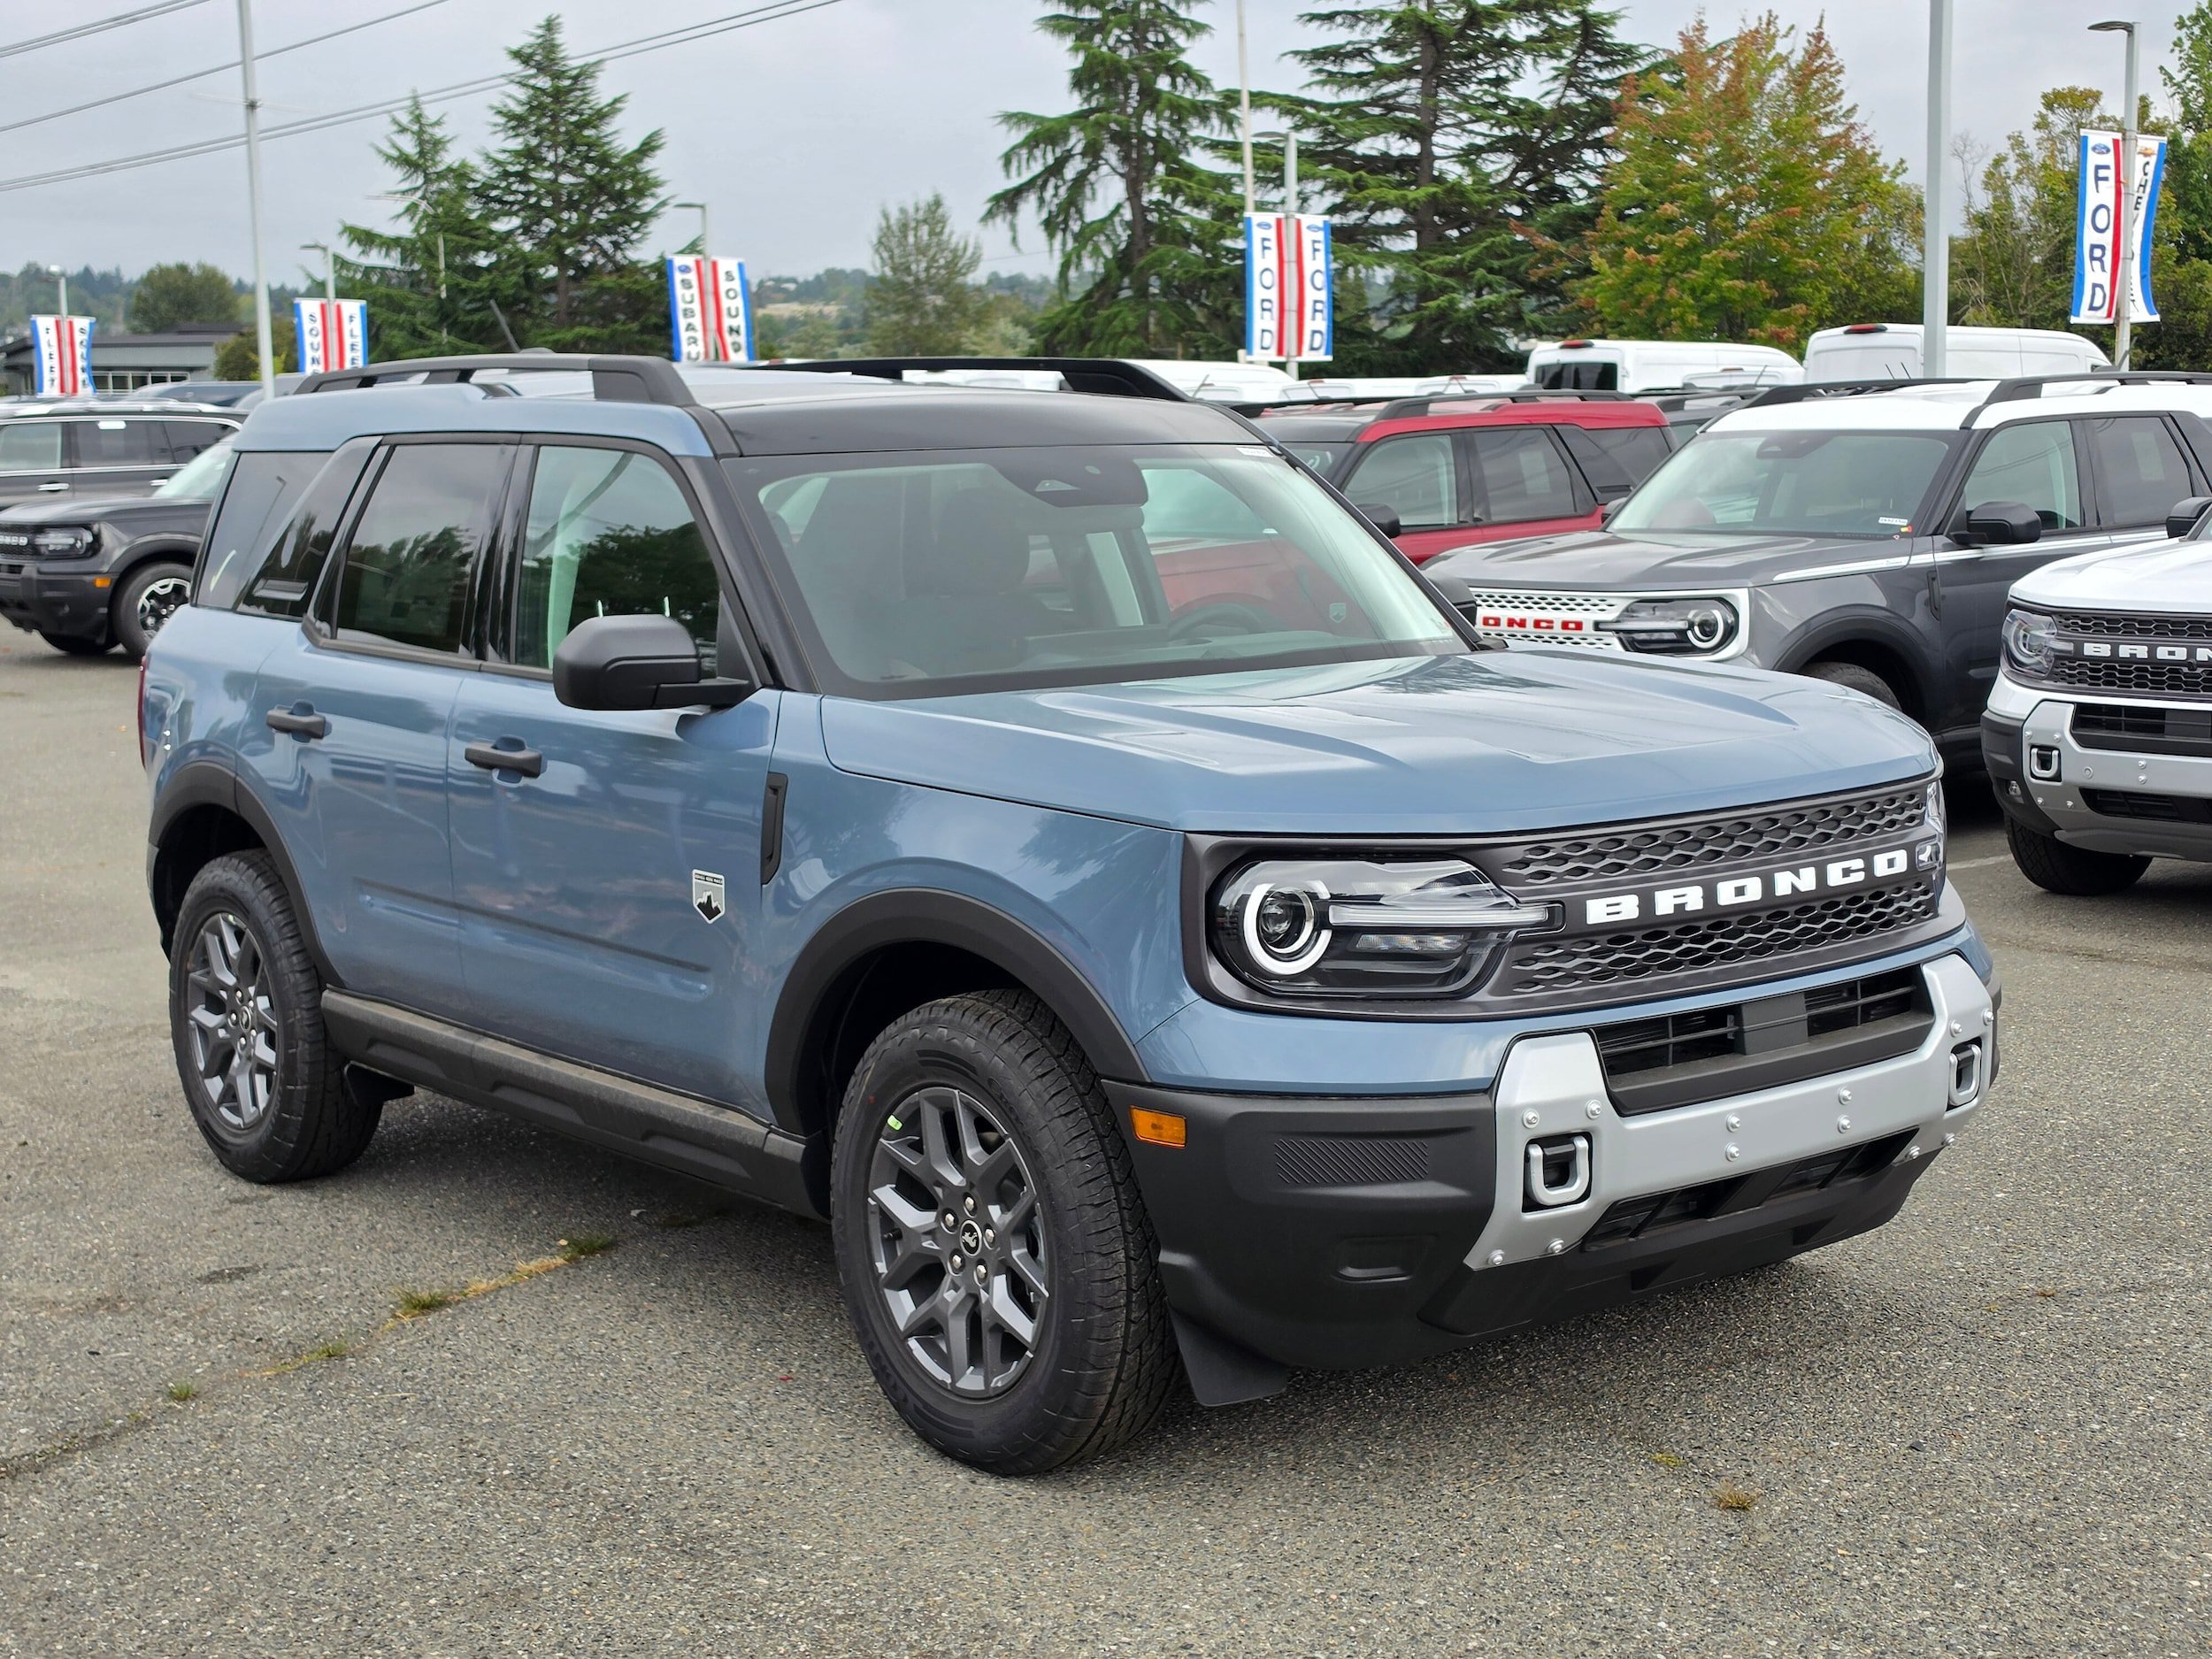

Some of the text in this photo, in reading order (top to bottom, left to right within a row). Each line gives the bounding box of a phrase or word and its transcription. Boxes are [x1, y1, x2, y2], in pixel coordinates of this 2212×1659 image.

[2088, 164, 2111, 311] FORD
[680, 278, 700, 361] SUBARU
[725, 271, 742, 353] SOUND
[1259, 237, 1275, 350] FORD
[1309, 240, 1325, 352] FORD
[348, 313, 359, 369] FLEE
[1585, 849, 1909, 926] BRONCO
